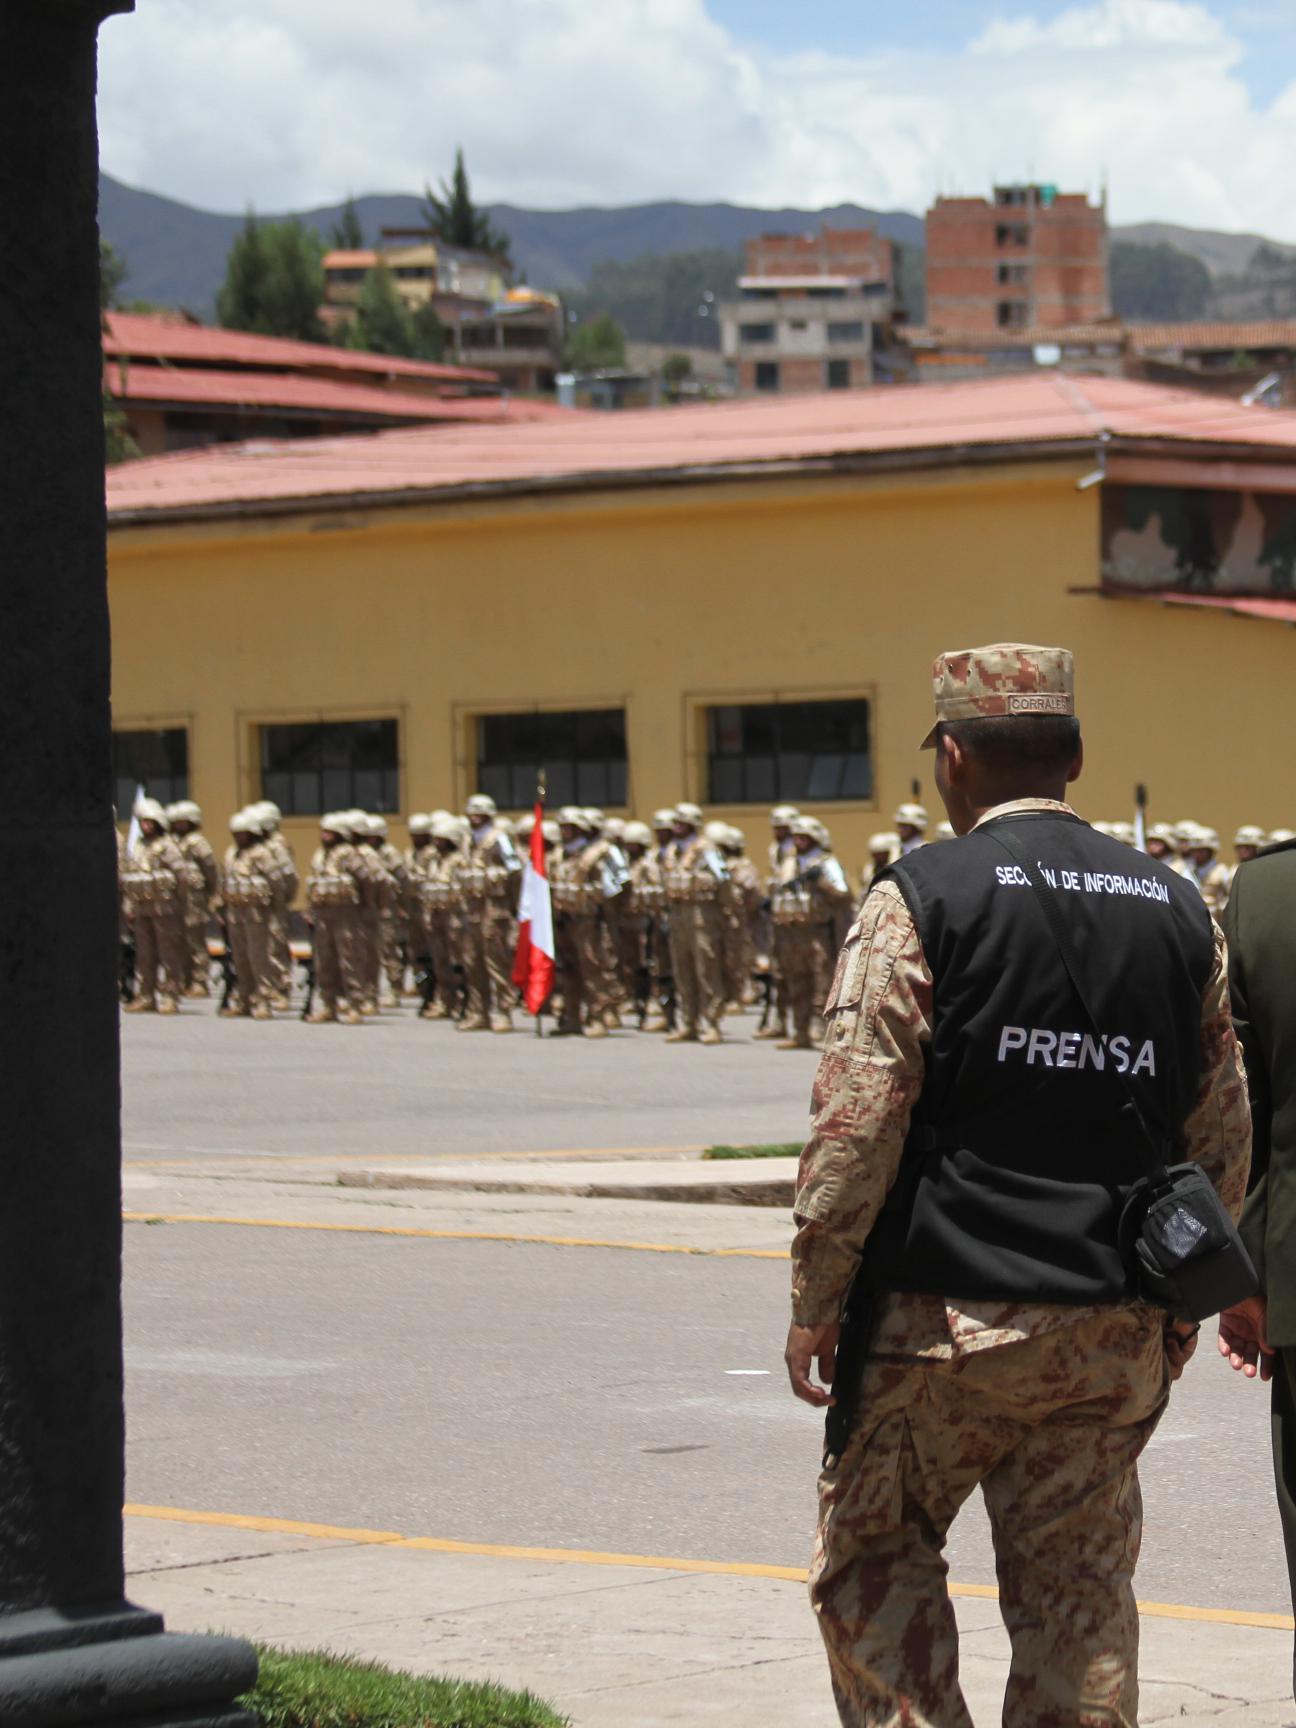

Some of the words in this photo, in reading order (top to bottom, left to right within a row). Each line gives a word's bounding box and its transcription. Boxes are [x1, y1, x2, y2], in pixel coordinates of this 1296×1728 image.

[1061, 871, 1081, 891] DE
[1084, 873, 1170, 904] INFORMACIÓN
[997, 1025, 1156, 1077] PRENSA
